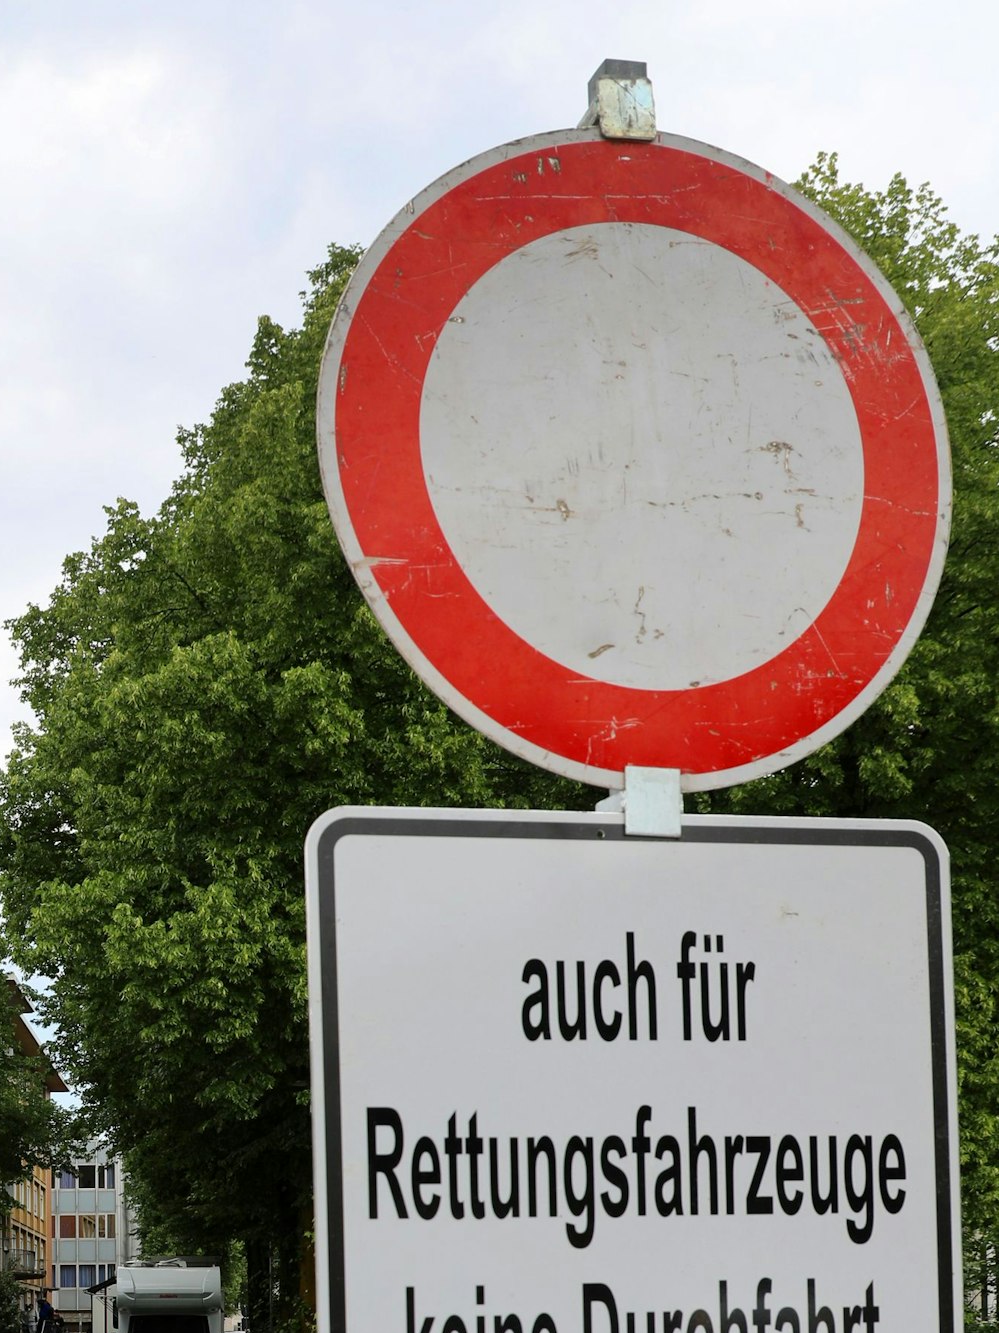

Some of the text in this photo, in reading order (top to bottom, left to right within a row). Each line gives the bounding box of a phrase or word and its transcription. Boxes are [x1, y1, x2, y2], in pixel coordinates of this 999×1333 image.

[522, 931, 756, 1042] auch für
[366, 1105, 907, 1249] Rettungsfahrzeuge
